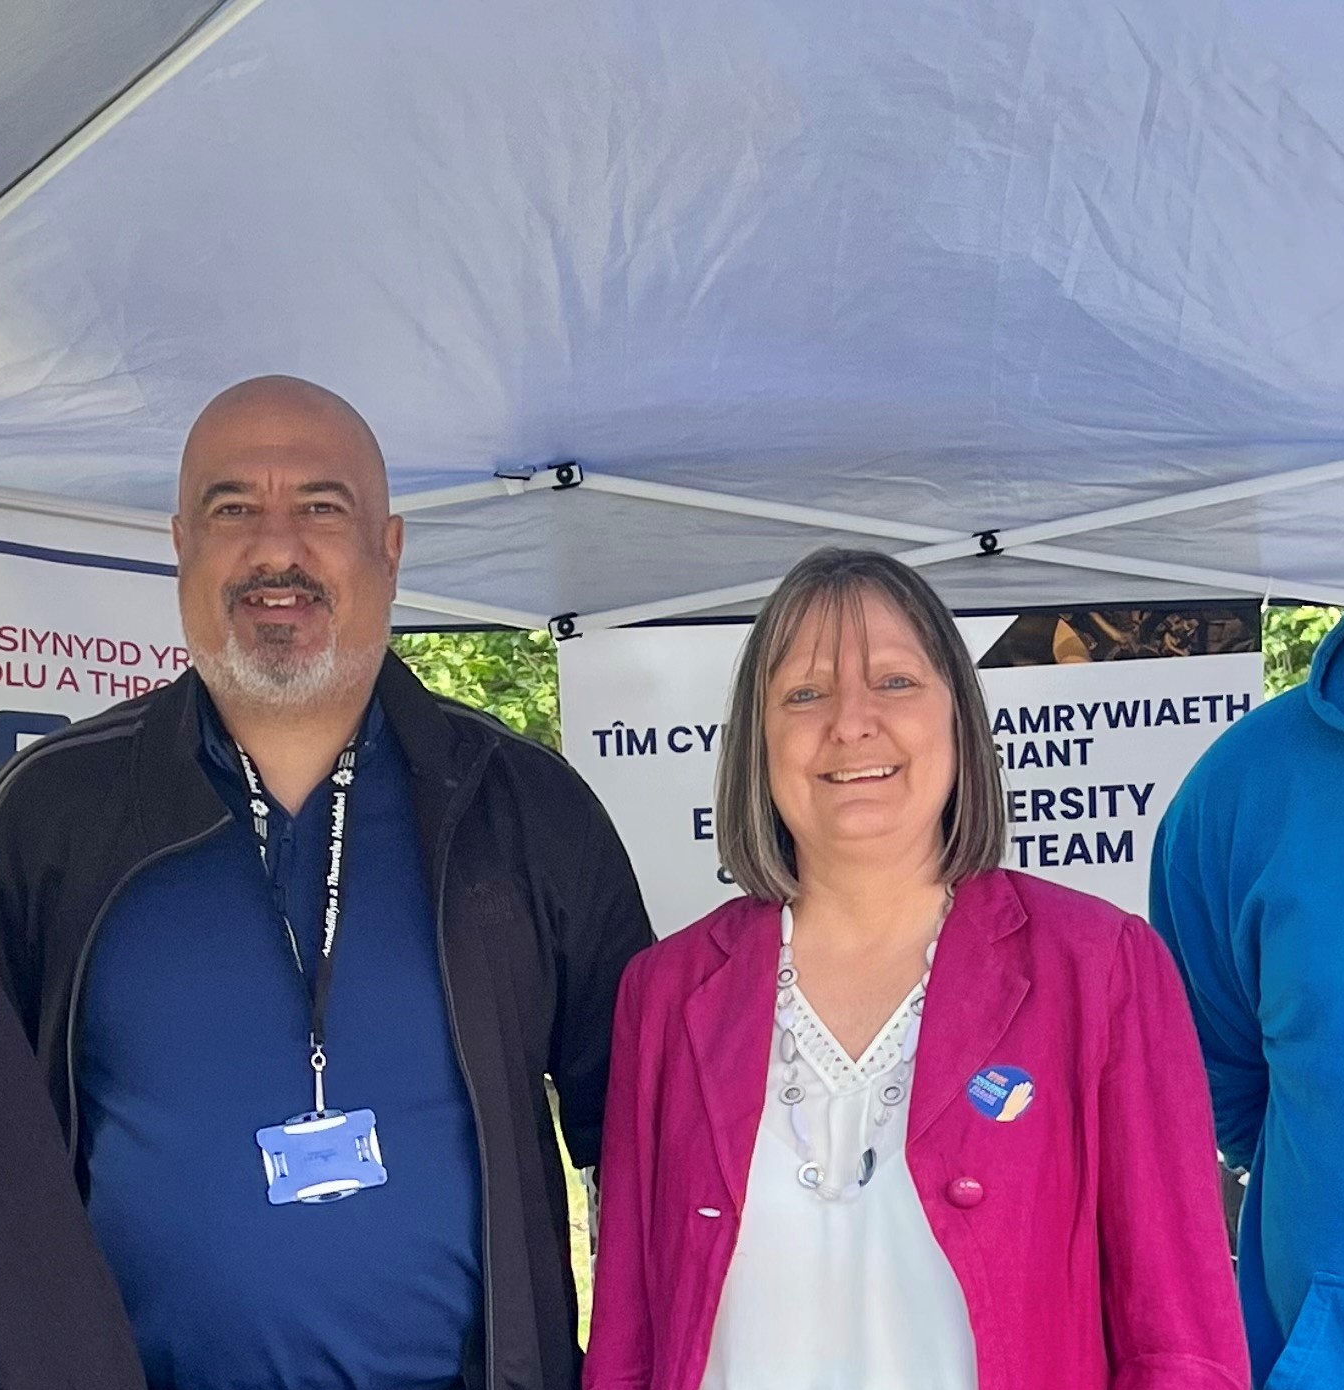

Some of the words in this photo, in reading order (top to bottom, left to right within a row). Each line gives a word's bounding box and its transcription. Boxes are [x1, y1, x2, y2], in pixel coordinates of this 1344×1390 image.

[150, 644, 191, 671] YR
[57, 667, 80, 692] A
[992, 693, 1250, 736] AMRYWIAETH
[592, 720, 658, 757] TÎM
[667, 724, 727, 753] CY
[1011, 830, 1134, 868] TEAM
